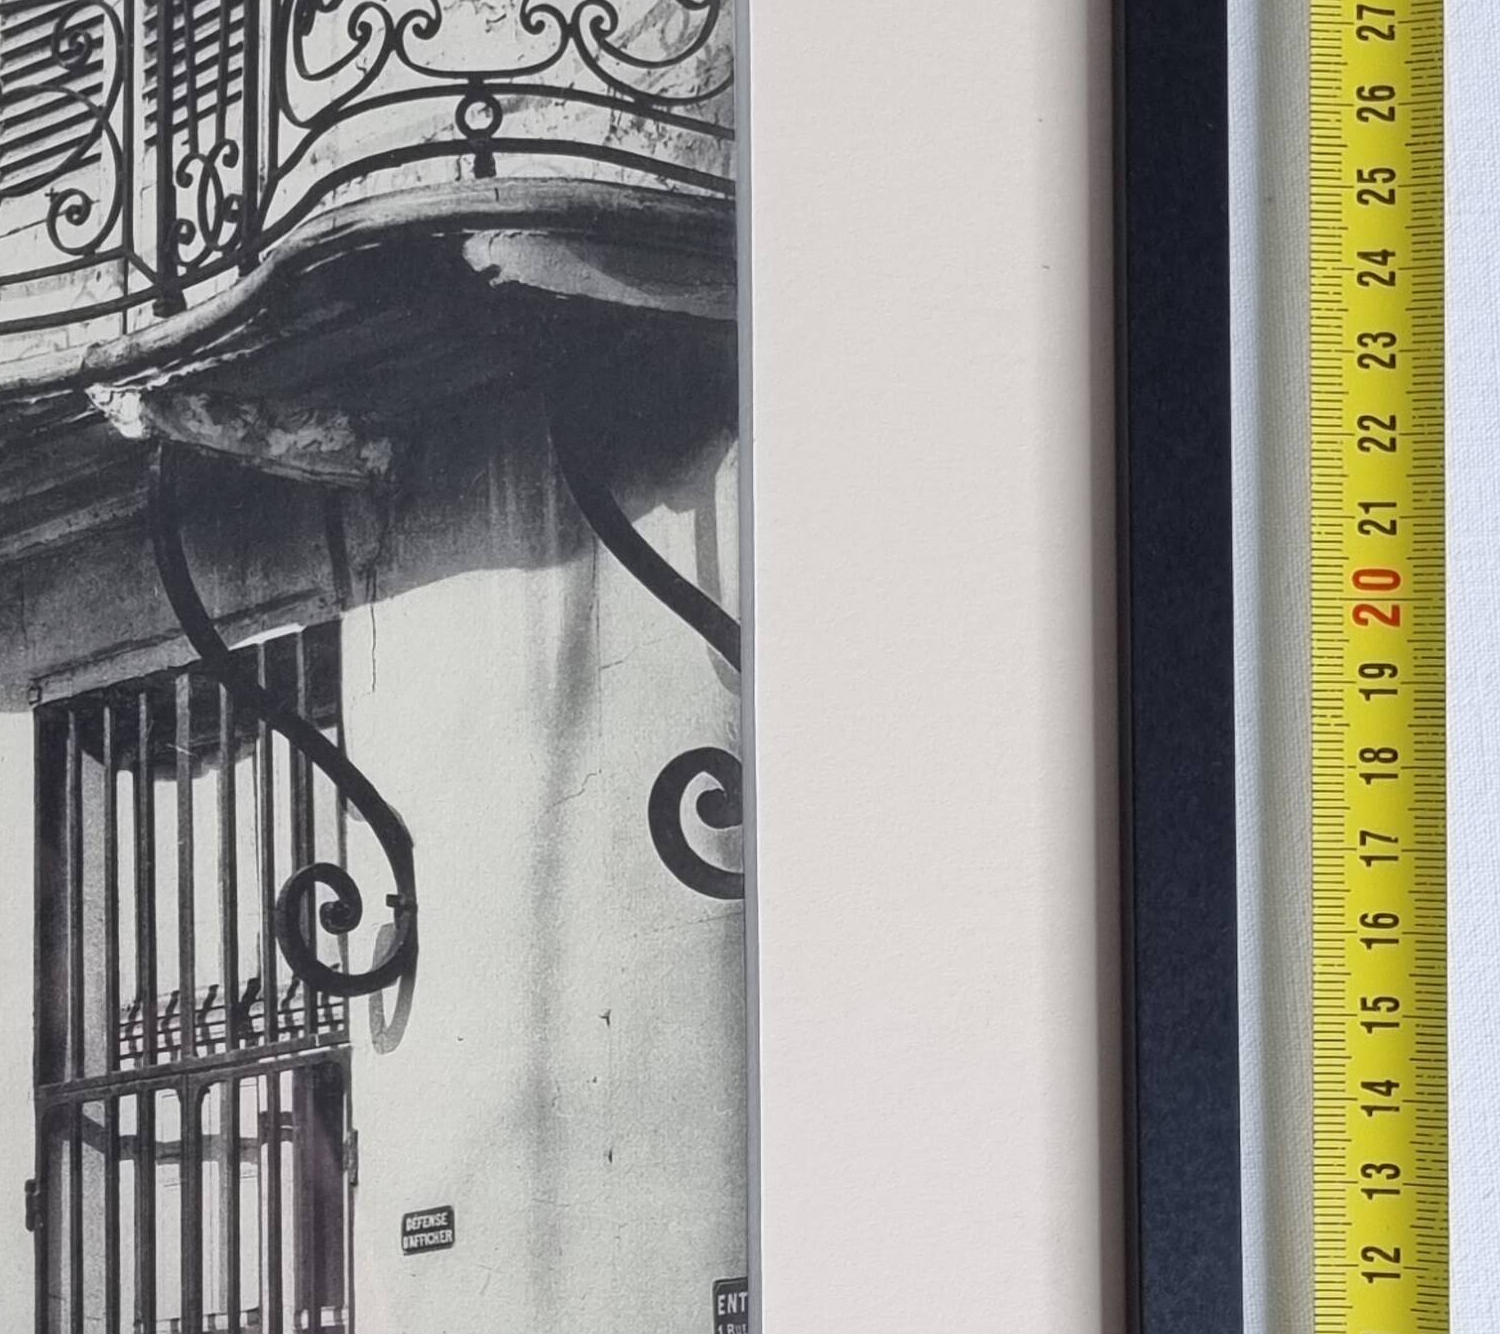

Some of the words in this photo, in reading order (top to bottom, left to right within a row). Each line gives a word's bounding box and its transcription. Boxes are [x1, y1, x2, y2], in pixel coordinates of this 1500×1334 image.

[1356, 4, 1396, 41] 27
[1356, 85, 1396, 123] 26
[1356, 168, 1396, 206] 25
[1356, 249, 1396, 287] 24
[1357, 331, 1397, 370] 23
[1357, 414, 1397, 453] 22
[1357, 502, 1397, 536] 21
[1351, 568, 1401, 627] 20
[1358, 663, 1399, 701] 19
[1358, 747, 1399, 785] 18
[1359, 830, 1400, 867] 17
[1359, 913, 1400, 950] 16
[1360, 996, 1401, 1034] 15
[1360, 1080, 1400, 1117] 14
[1360, 1163, 1402, 1200] 13
[1361, 1246, 1403, 1284] 12
